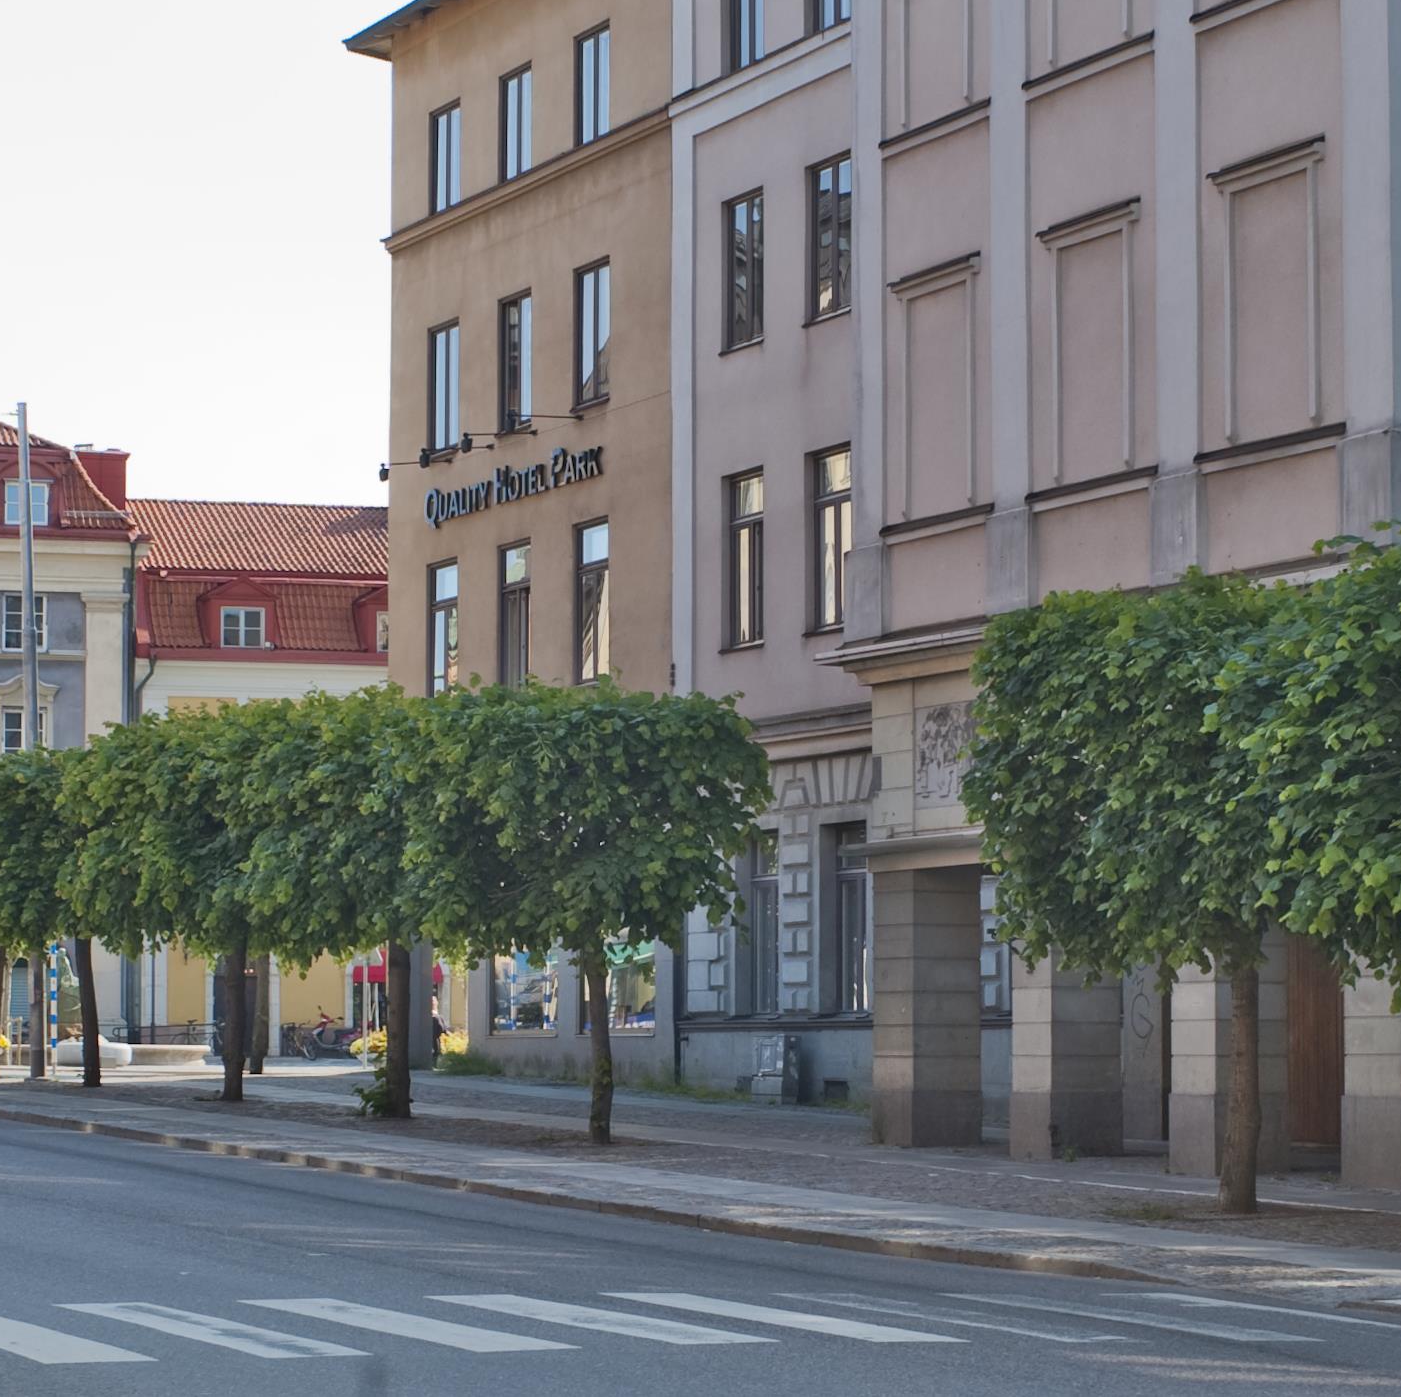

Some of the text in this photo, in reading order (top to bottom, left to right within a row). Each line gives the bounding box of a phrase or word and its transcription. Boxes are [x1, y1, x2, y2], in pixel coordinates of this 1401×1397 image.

[424, 446, 604, 529] QUALITY HOTEL PARK
